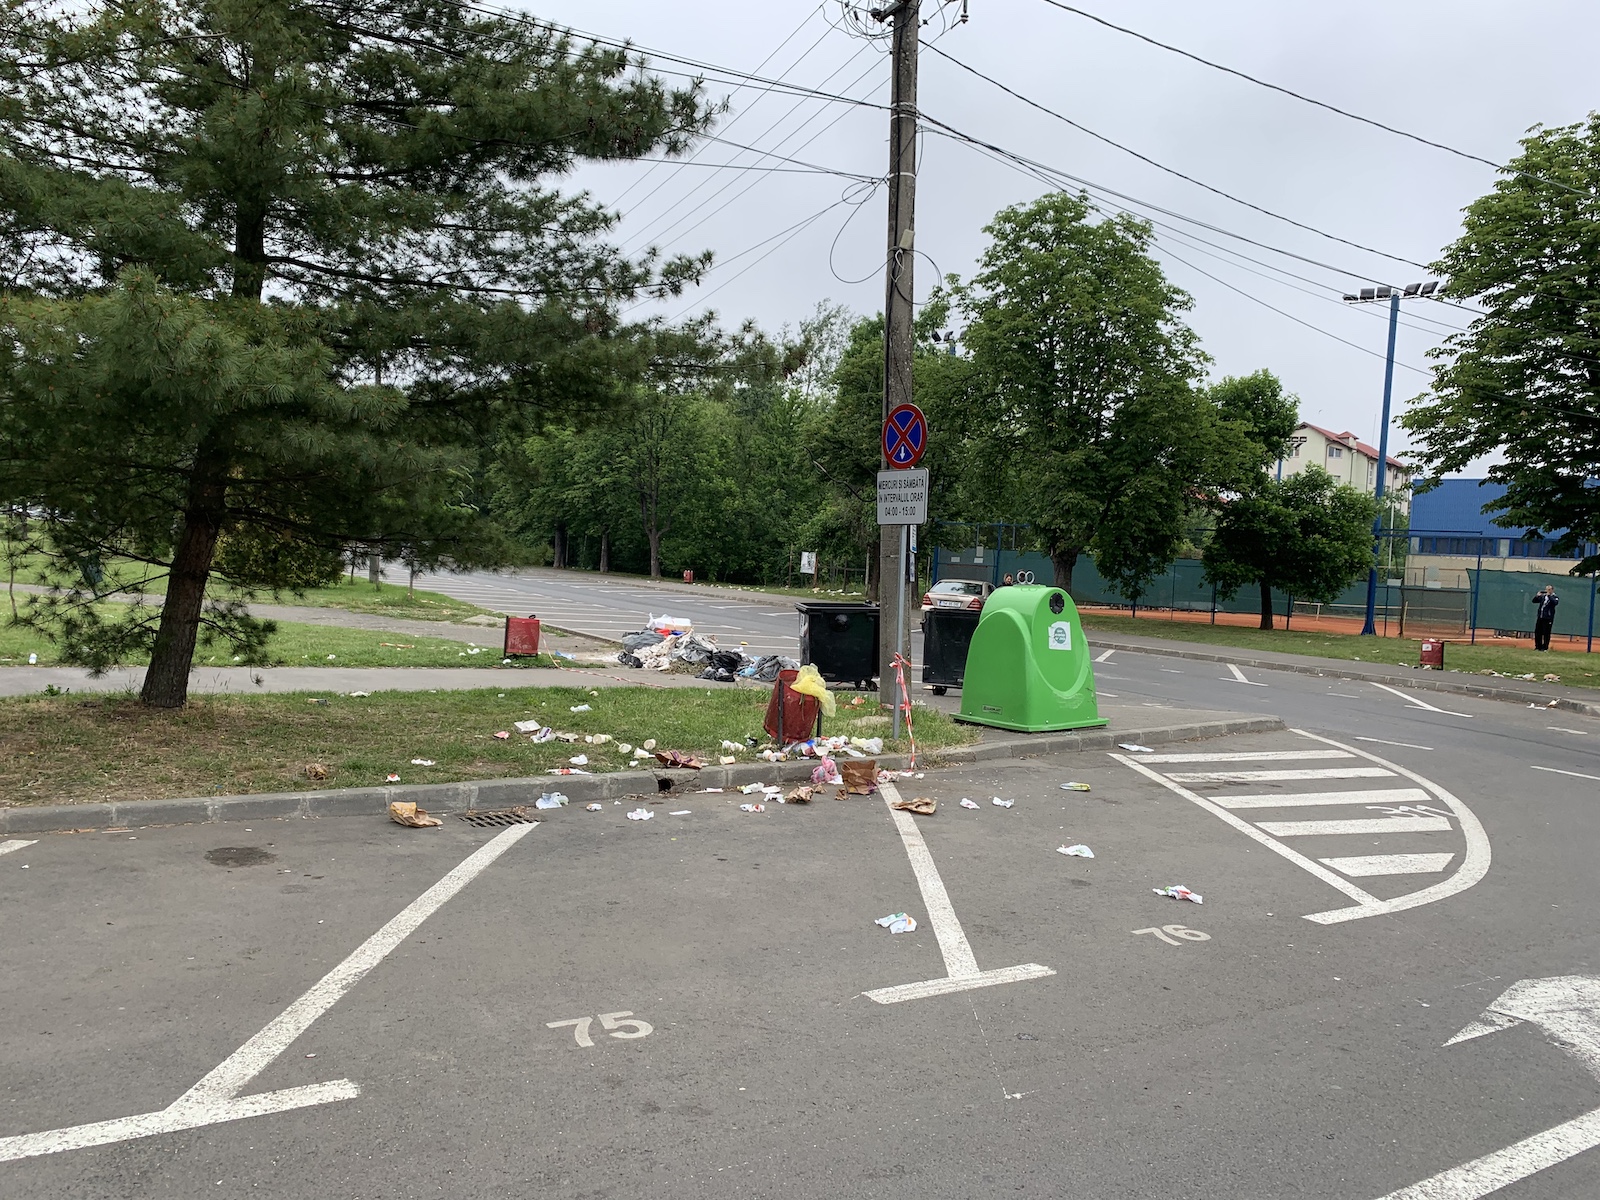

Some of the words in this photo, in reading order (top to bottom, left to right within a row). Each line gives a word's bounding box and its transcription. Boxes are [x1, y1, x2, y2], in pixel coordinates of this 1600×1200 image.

[879, 480, 898, 489] MIERCURI
[884, 493, 909, 503] INTERVALUL
[910, 492, 924, 502] ORAR
[885, 507, 898, 516] 04:00
[903, 506, 916, 516] 15:00
[1130, 924, 1212, 946] 76
[545, 1010, 654, 1048] 75
